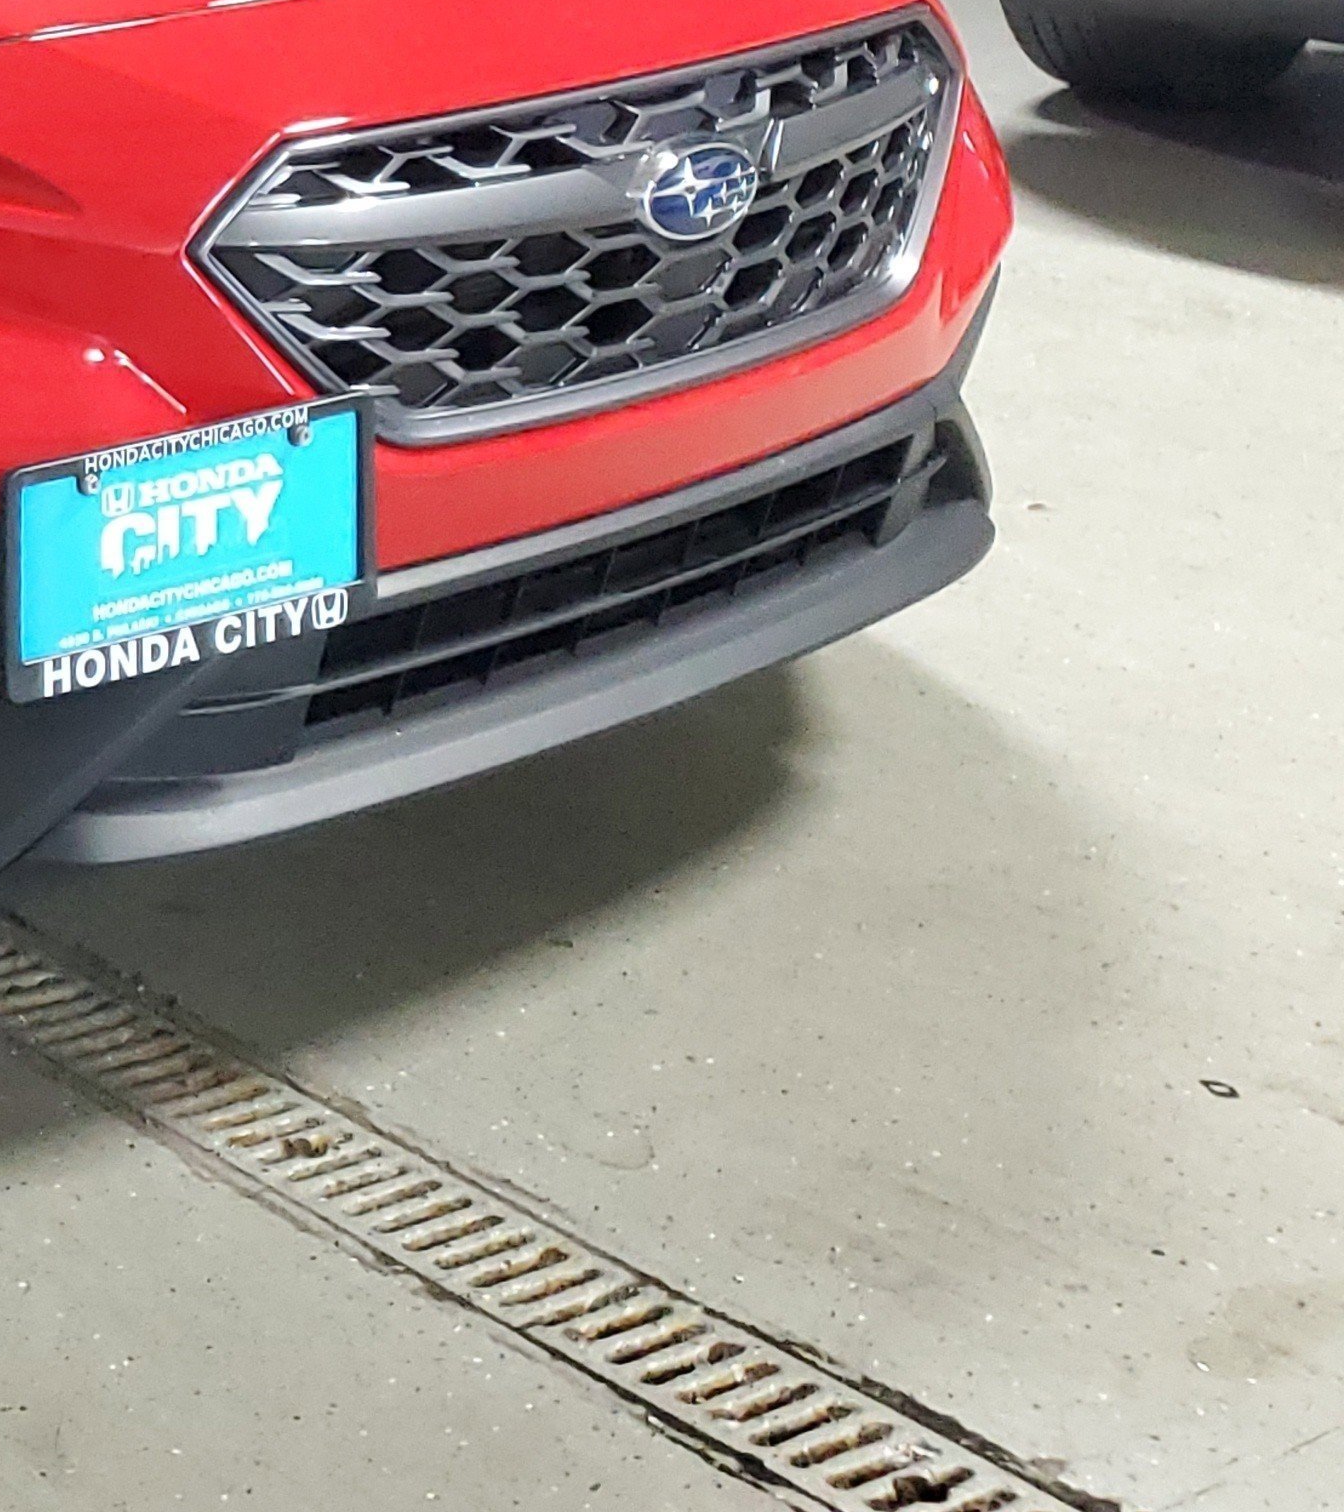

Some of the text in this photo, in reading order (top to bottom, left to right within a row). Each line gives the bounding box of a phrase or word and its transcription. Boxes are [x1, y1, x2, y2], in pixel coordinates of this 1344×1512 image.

[84, 406, 309, 475] HONDACITYCHICAGO.COM
[139, 452, 285, 507] HONDA
[100, 479, 284, 580] CITY
[43, 624, 201, 698] HONDA
[215, 596, 309, 655] CITY
